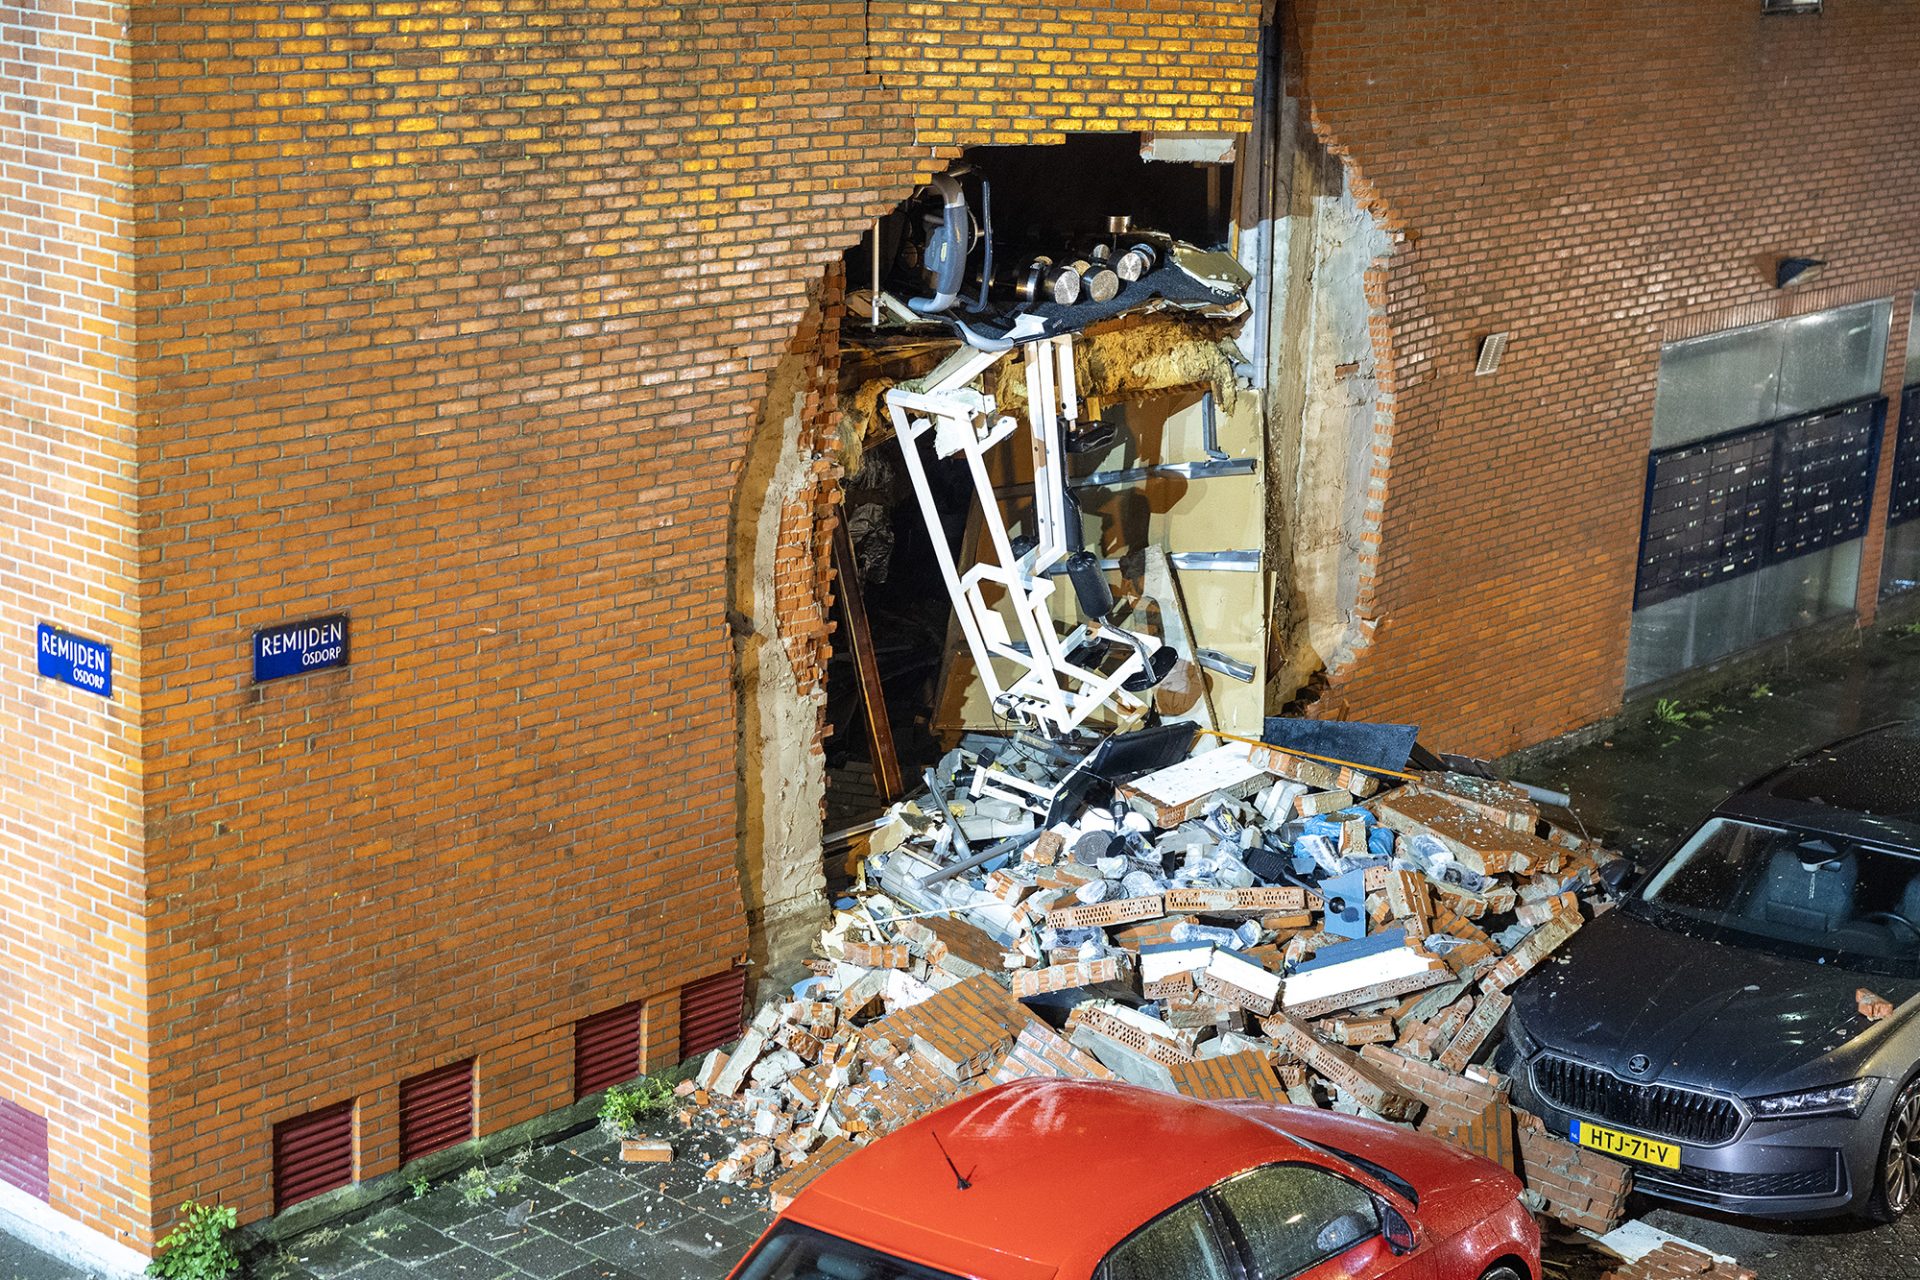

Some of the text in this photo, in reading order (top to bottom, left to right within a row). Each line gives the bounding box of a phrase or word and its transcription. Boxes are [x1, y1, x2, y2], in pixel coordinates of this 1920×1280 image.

[42, 632, 105, 672] REMIJDEN
[262, 622, 341, 657] REMIJDEN
[302, 646, 342, 665] OSDORP
[73, 668, 105, 689] OSDORP
[1591, 1128, 1668, 1162] HTJ-71-V
